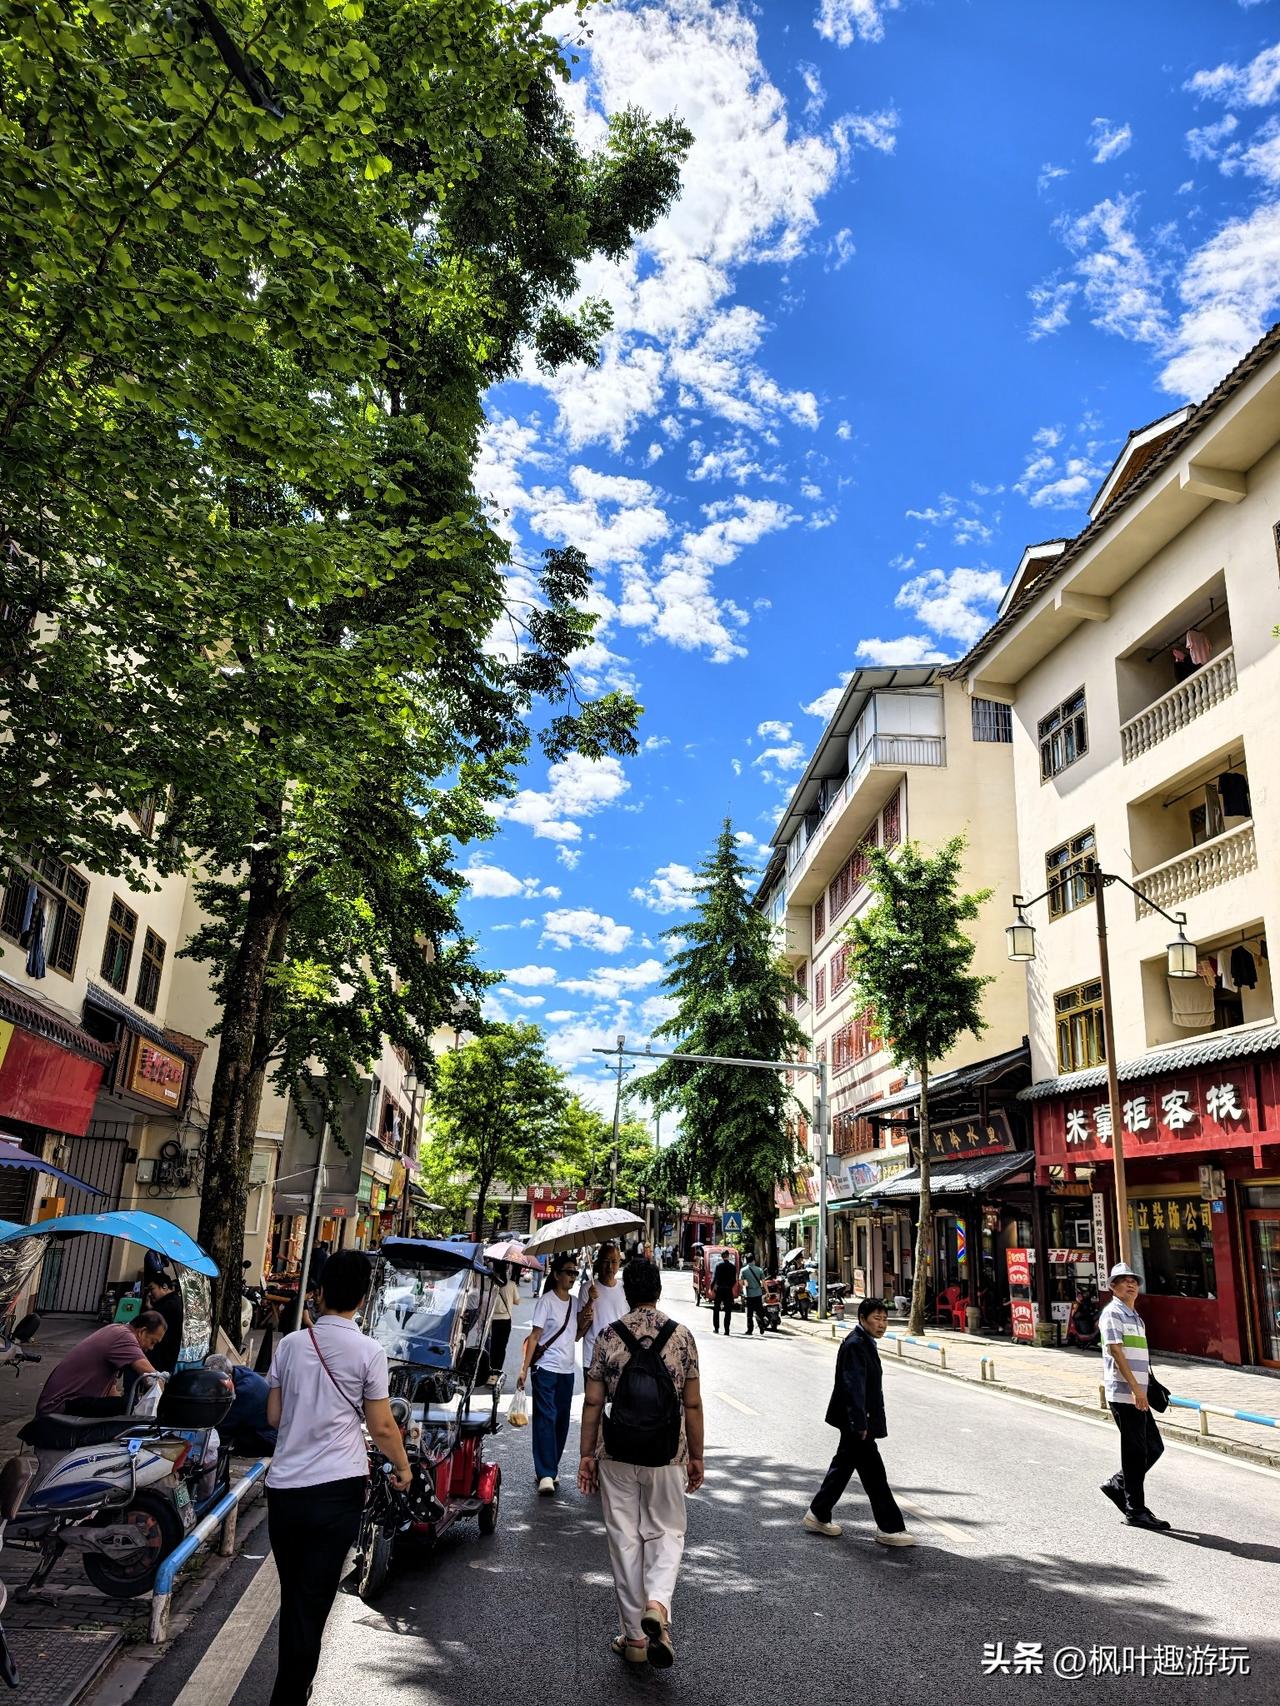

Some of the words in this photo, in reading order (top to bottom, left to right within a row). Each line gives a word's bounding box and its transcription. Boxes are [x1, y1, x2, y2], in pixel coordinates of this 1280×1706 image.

[1066, 1083, 1243, 1144] 米掌柜客栈
